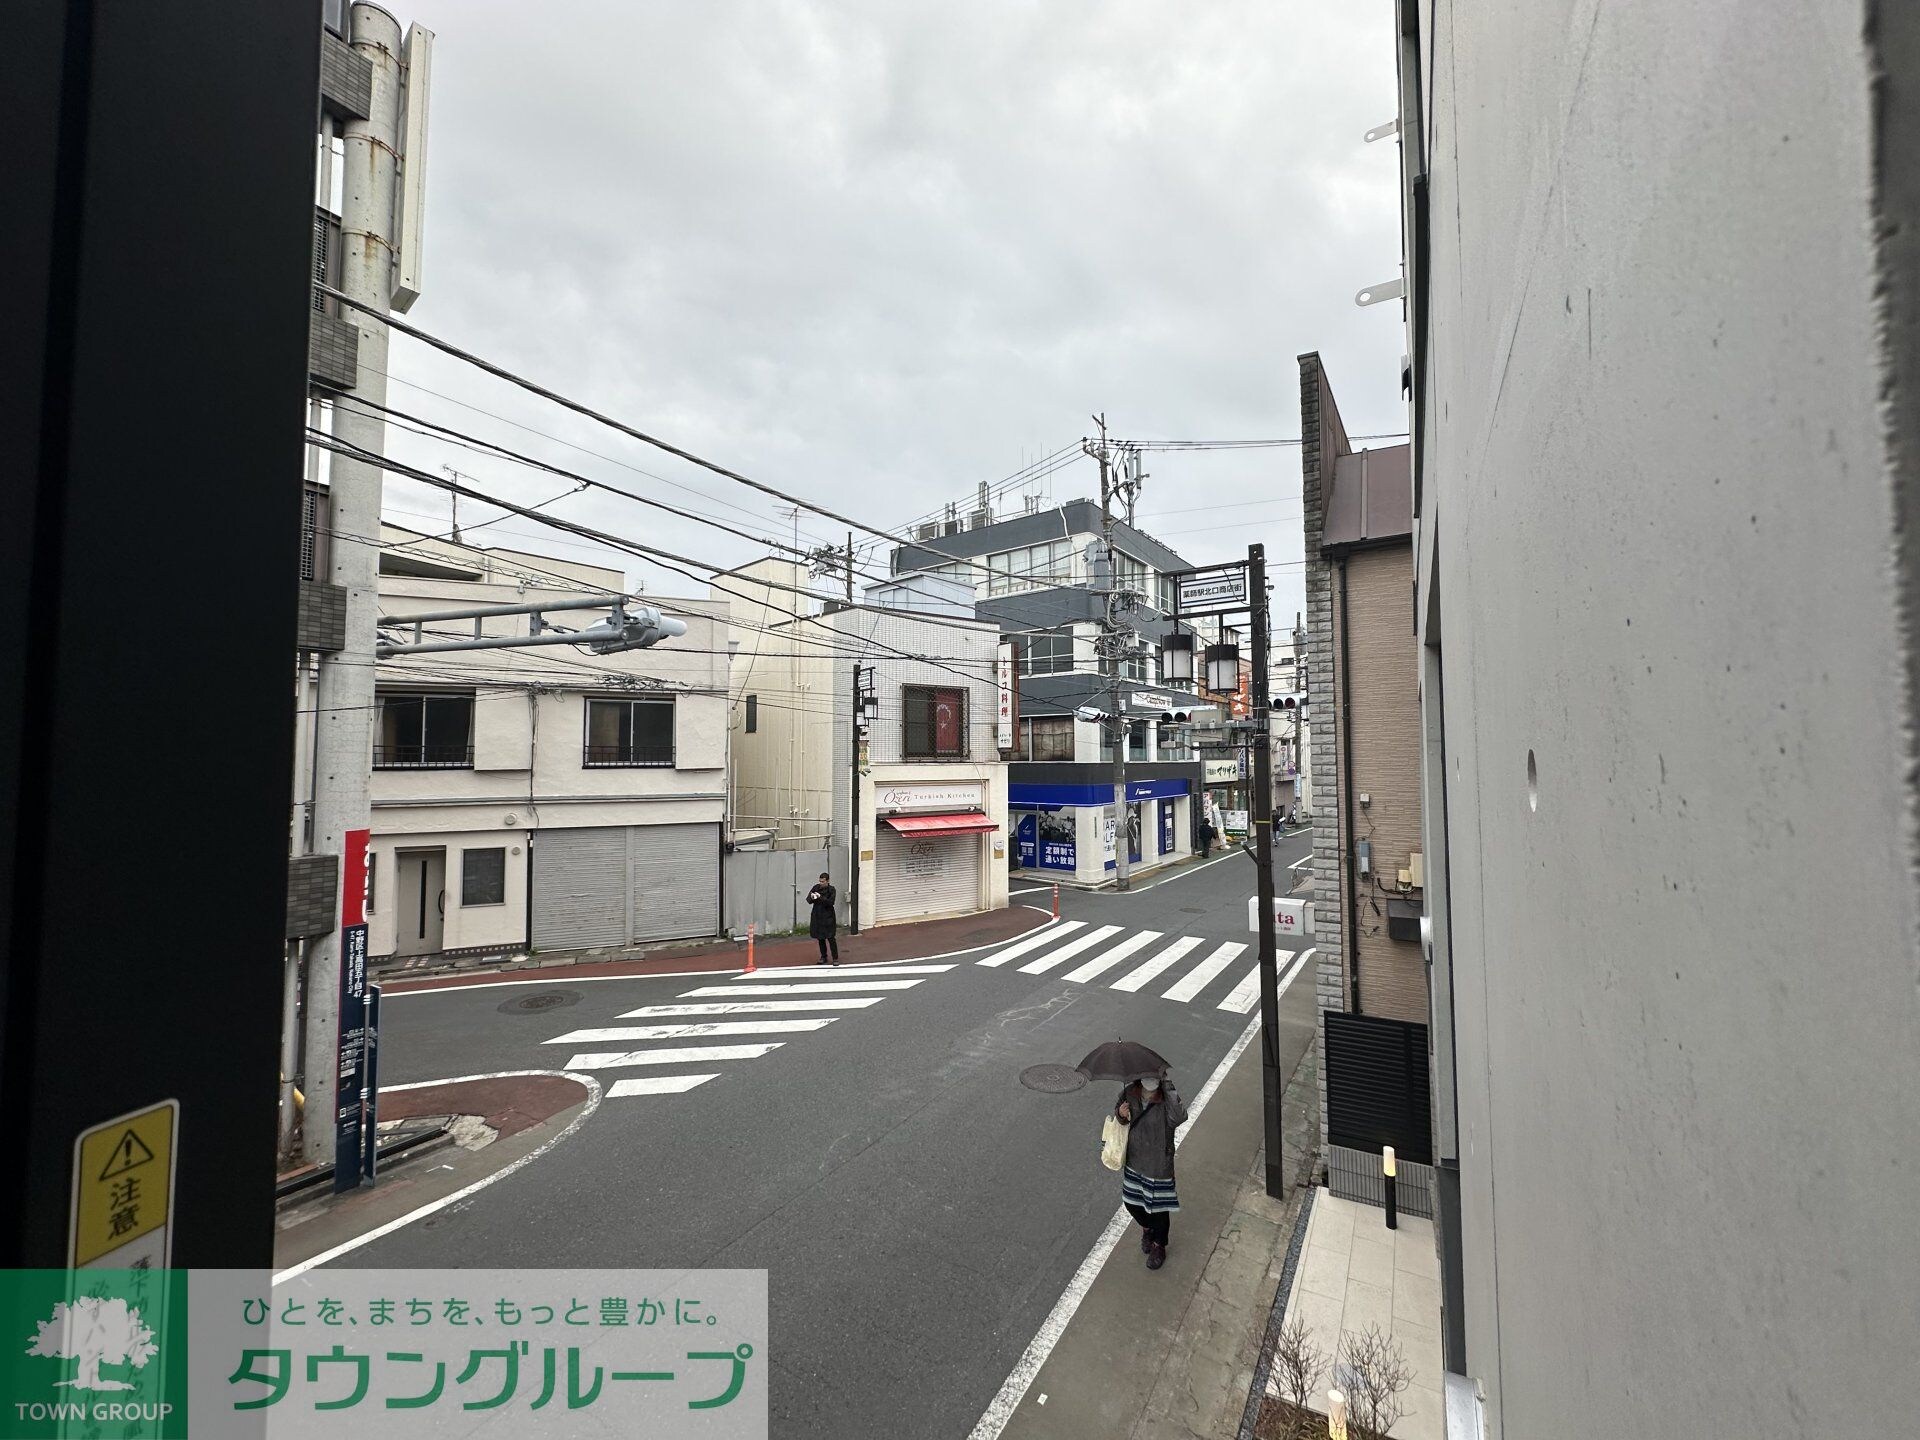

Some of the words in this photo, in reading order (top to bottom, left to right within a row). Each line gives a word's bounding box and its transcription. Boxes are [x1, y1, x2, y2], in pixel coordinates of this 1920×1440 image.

[1183, 584, 1242, 599] 薬師駅北口商店街
[1045, 846, 1075, 856] 定額制で
[1045, 855, 1075, 866] 通い放題
[108, 1177, 142, 1242] 注意
